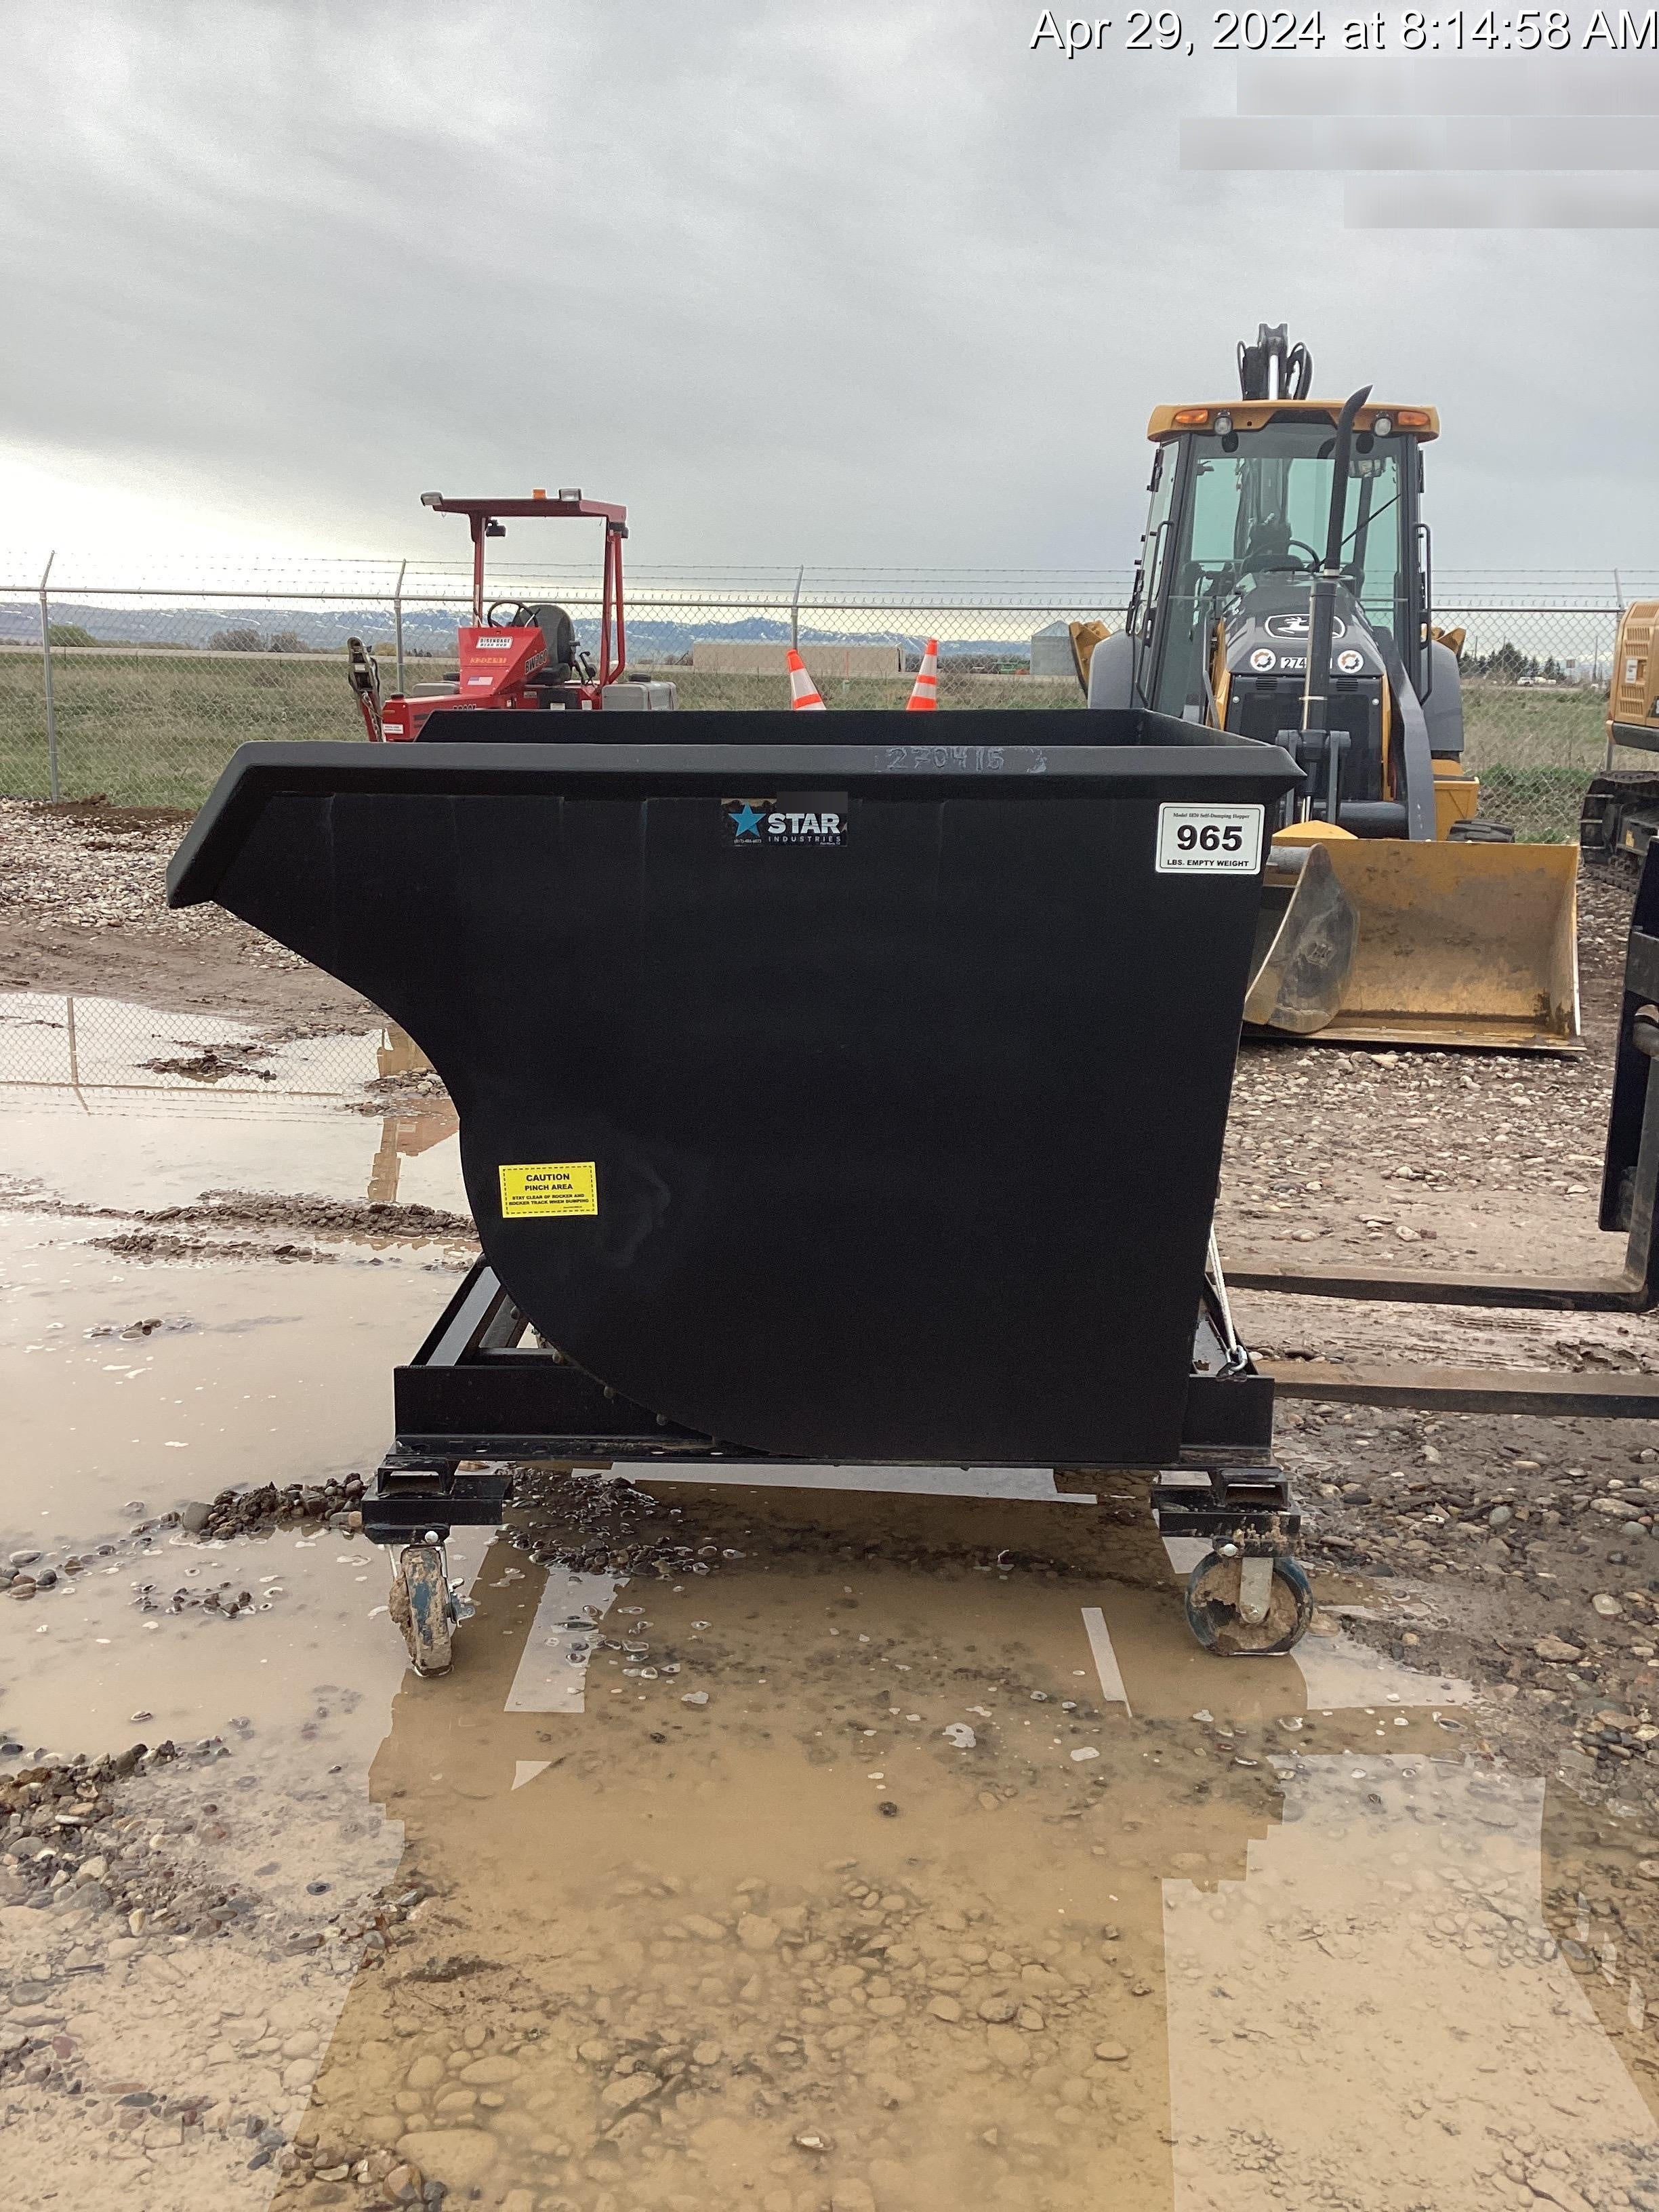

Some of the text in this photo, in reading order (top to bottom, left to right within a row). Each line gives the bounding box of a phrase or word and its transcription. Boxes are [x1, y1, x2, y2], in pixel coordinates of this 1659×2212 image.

[767, 813, 840, 834] STAR
[1177, 824, 1243, 851] 965
[526, 1173, 570, 1182] CAUTION
